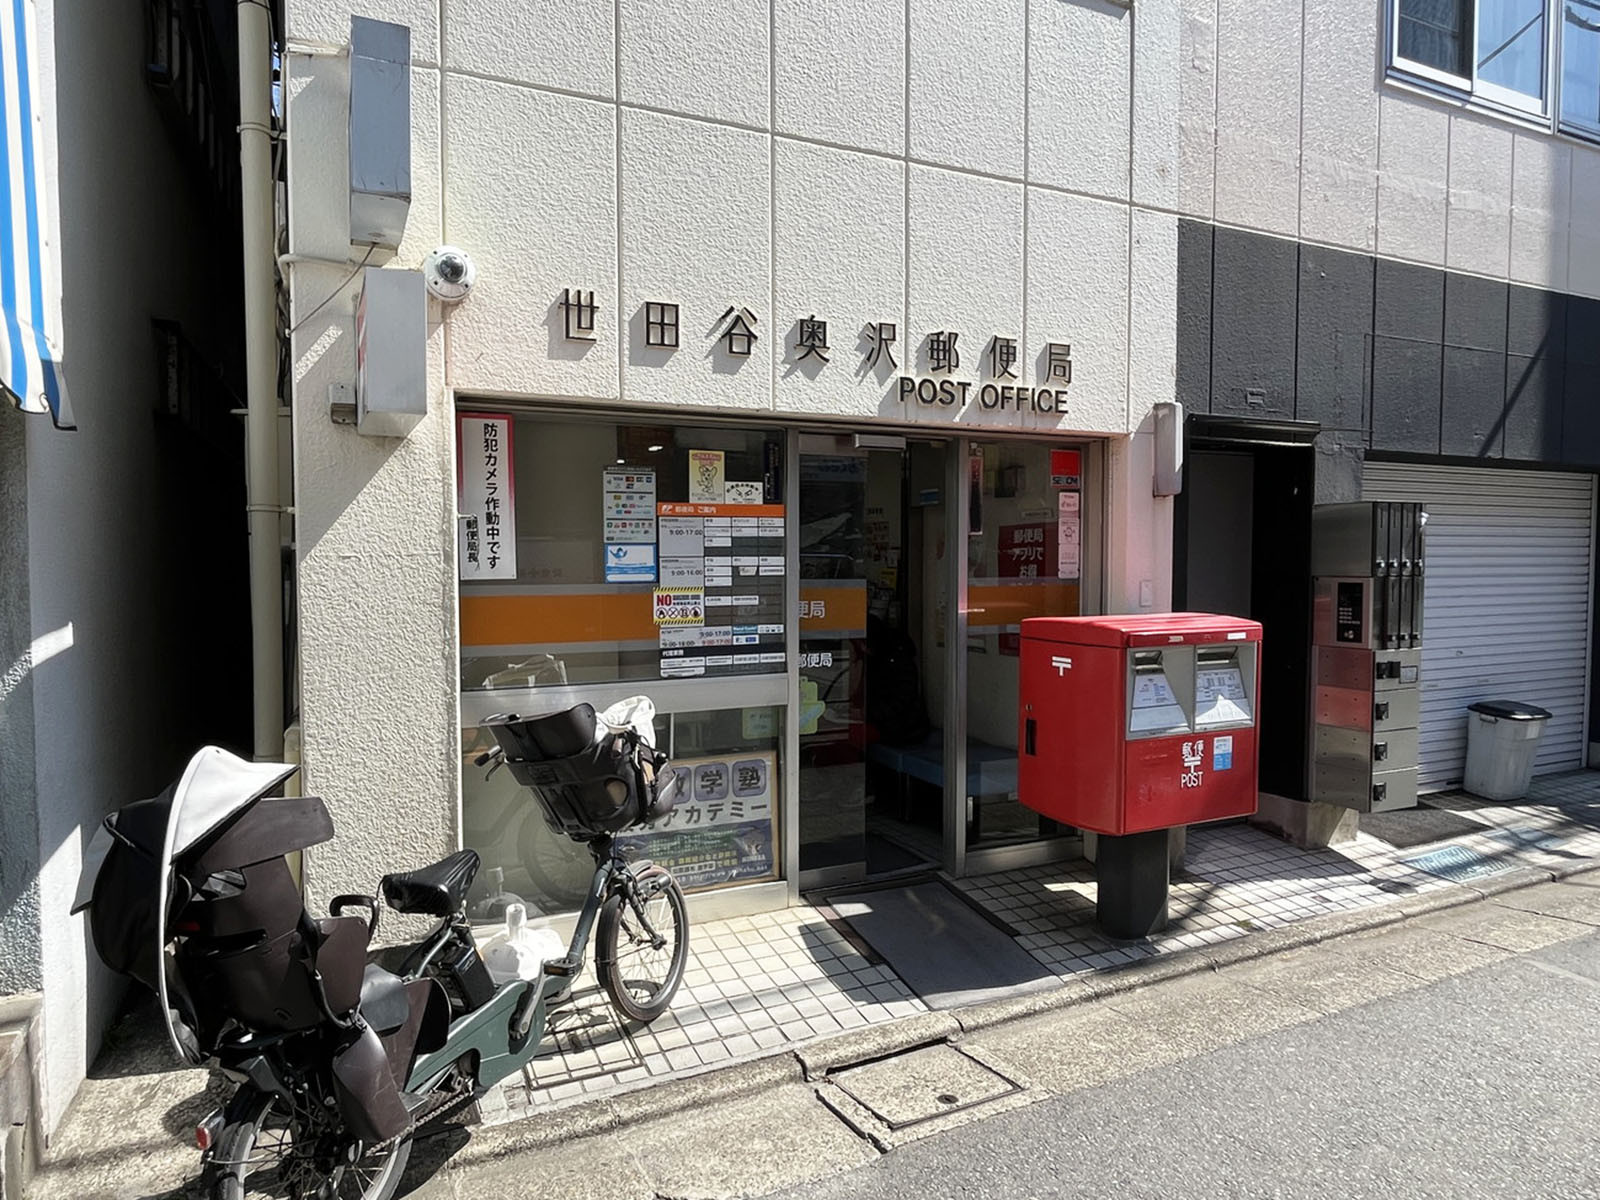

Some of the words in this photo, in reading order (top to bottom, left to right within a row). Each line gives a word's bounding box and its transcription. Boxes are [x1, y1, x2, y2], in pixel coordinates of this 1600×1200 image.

[559, 288, 1073, 384] 世田谷奥沢郵便局
[899, 376, 972, 406] POST
[980, 384, 1069, 414] OFFICE
[483, 423, 501, 570] 防犯カメラ作動中です
[466, 519, 479, 563] 郵便局長
[656, 594, 672, 607] NO
[1182, 739, 1205, 759] 郵便
[1181, 771, 1204, 789] POST
